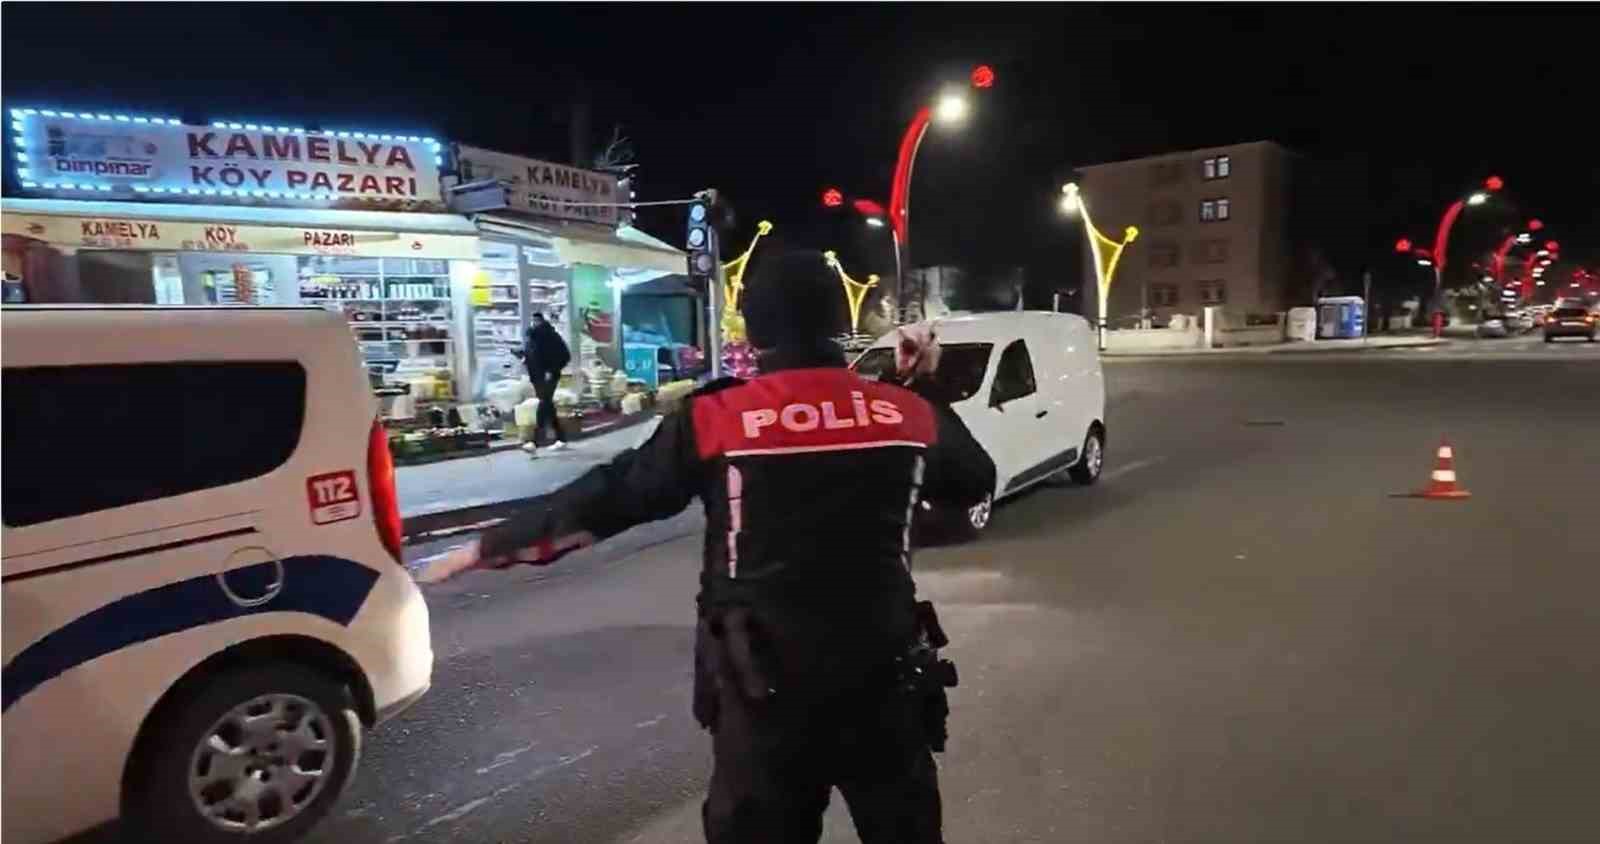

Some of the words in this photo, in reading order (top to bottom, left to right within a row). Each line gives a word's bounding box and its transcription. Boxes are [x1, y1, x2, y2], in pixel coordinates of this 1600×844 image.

[186, 132, 415, 170] KAMELYA
[190, 162, 272, 188] KÖY
[287, 170, 417, 196] PAZARI
[80, 221, 160, 240] KAMELYA
[303, 231, 355, 246] PAZARI
[741, 391, 904, 438] POLİS
[312, 477, 354, 503] 112
